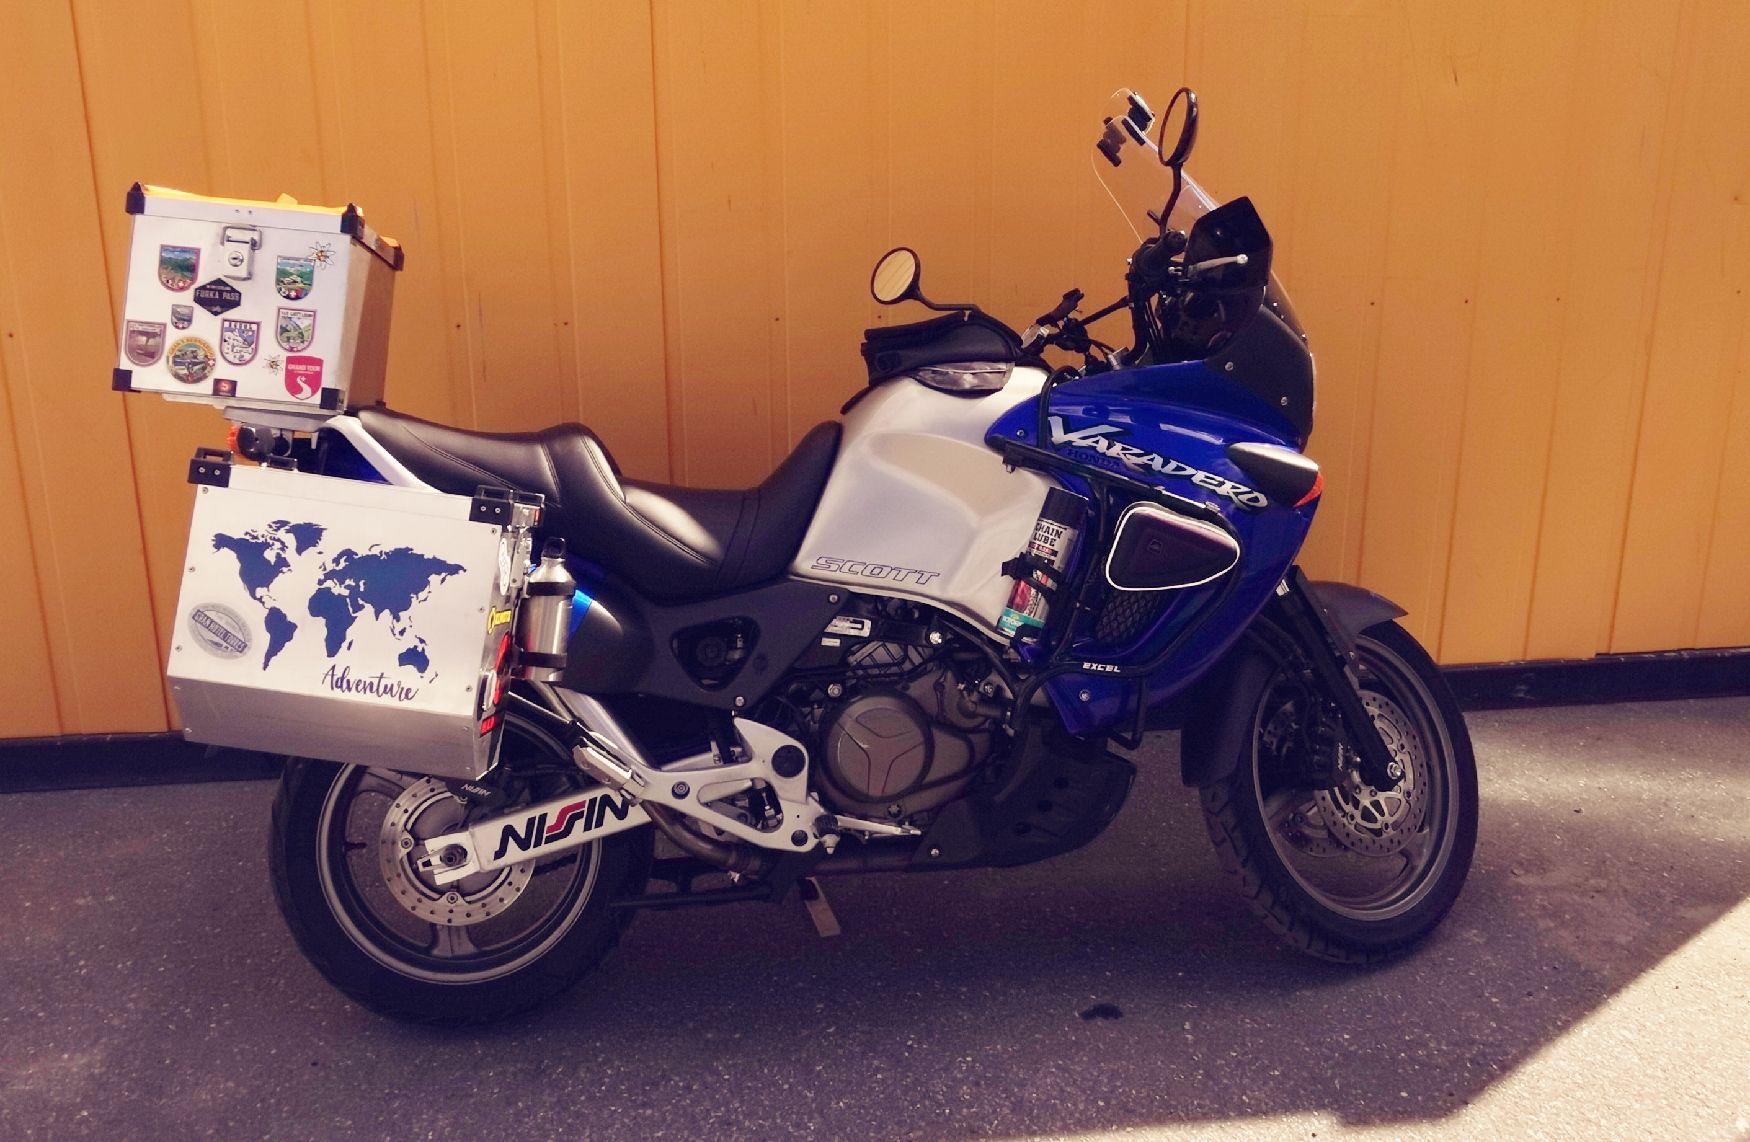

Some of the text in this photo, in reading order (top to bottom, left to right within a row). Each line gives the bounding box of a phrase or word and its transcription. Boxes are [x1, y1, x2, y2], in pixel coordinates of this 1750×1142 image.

[196, 289, 219, 299] FURKA
[1048, 415, 1269, 511] VARADERO
[1067, 448, 1120, 469] HONDA
[1033, 532, 1057, 547] LUBE
[1035, 522, 1063, 540] CHAIN
[811, 556, 941, 585] SCOTT
[1083, 662, 1121, 673] EXCEL
[321, 663, 419, 702] Adventure
[493, 793, 634, 861] NISSIN
